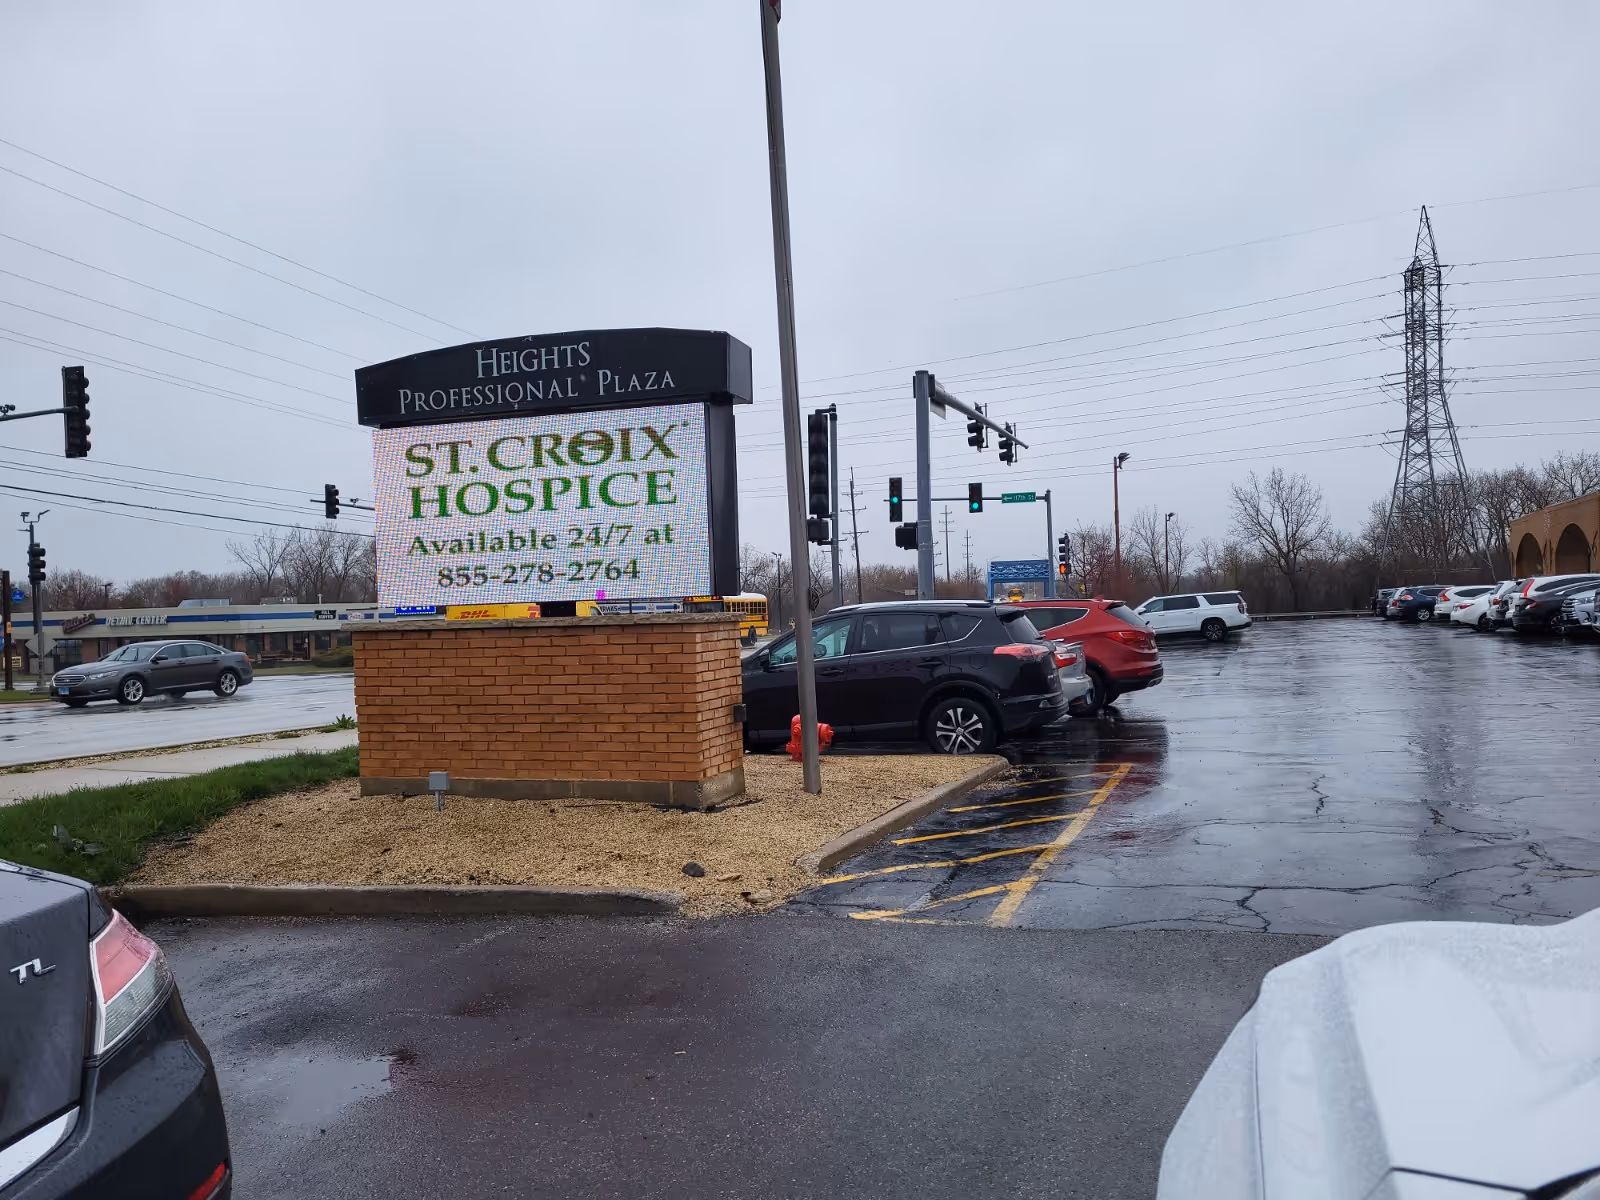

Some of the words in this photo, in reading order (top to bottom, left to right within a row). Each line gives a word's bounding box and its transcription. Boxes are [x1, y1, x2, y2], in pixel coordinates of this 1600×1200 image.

[475, 341, 591, 379] HEIGHTS
[398, 377, 579, 415] PROFESSIONAL
[597, 369, 676, 396] PLAZA
[405, 439, 479, 478] ST.
[487, 424, 681, 472] CROIX
[407, 469, 677, 520] HOSPICE
[407, 528, 558, 557] Available
[568, 523, 634, 548] 24/7
[644, 523, 675, 546] at
[438, 558, 641, 588] 855-278-2764
